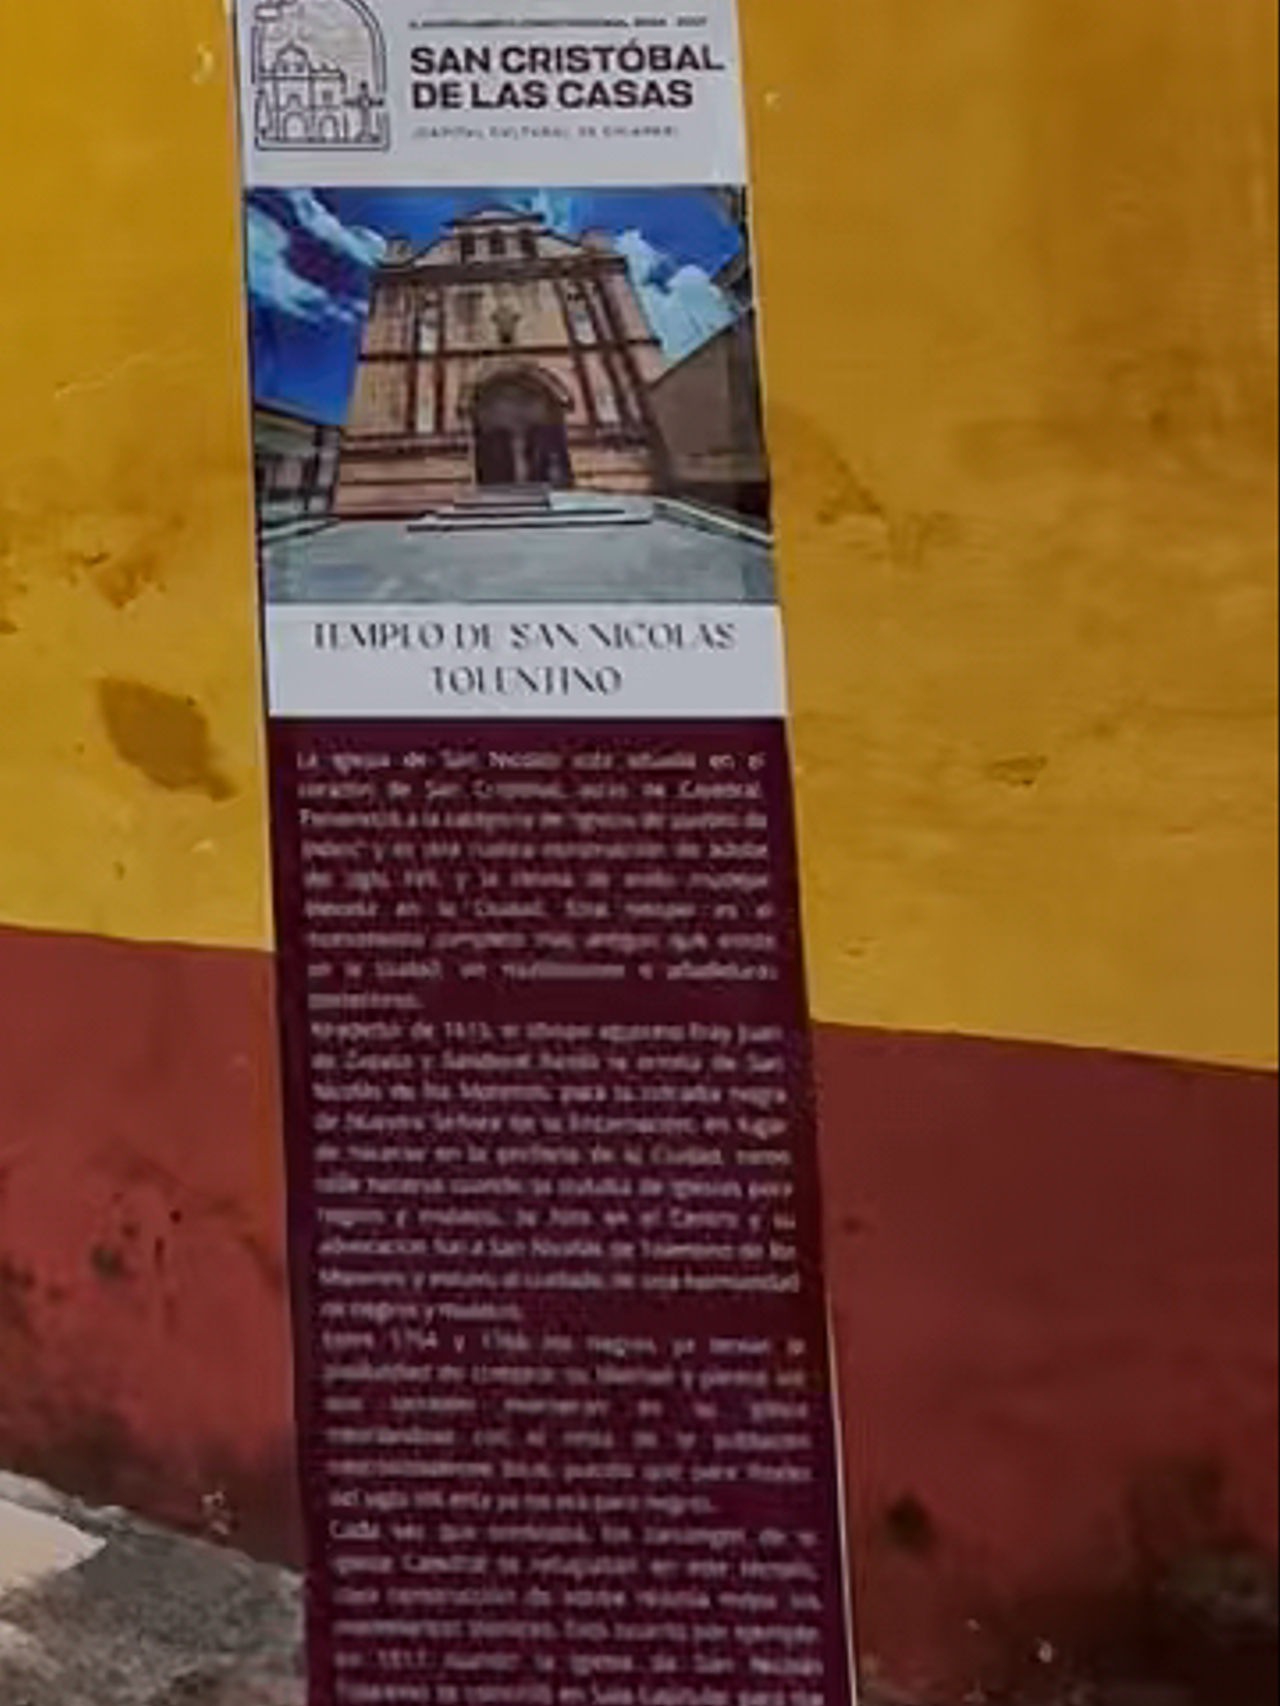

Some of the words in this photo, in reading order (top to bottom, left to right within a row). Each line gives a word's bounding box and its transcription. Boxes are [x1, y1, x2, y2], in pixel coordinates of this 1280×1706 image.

[410, 46, 491, 74] SAN
[499, 37, 726, 74] CRISTÓBAL
[413, 82, 461, 109] DE
[470, 81, 549, 109] LAS
[556, 80, 694, 108] CASAS
[313, 622, 445, 650] TEMPLO
[455, 622, 492, 650] DE
[510, 622, 580, 649] SAN
[432, 665, 623, 695] TOLENTINO
